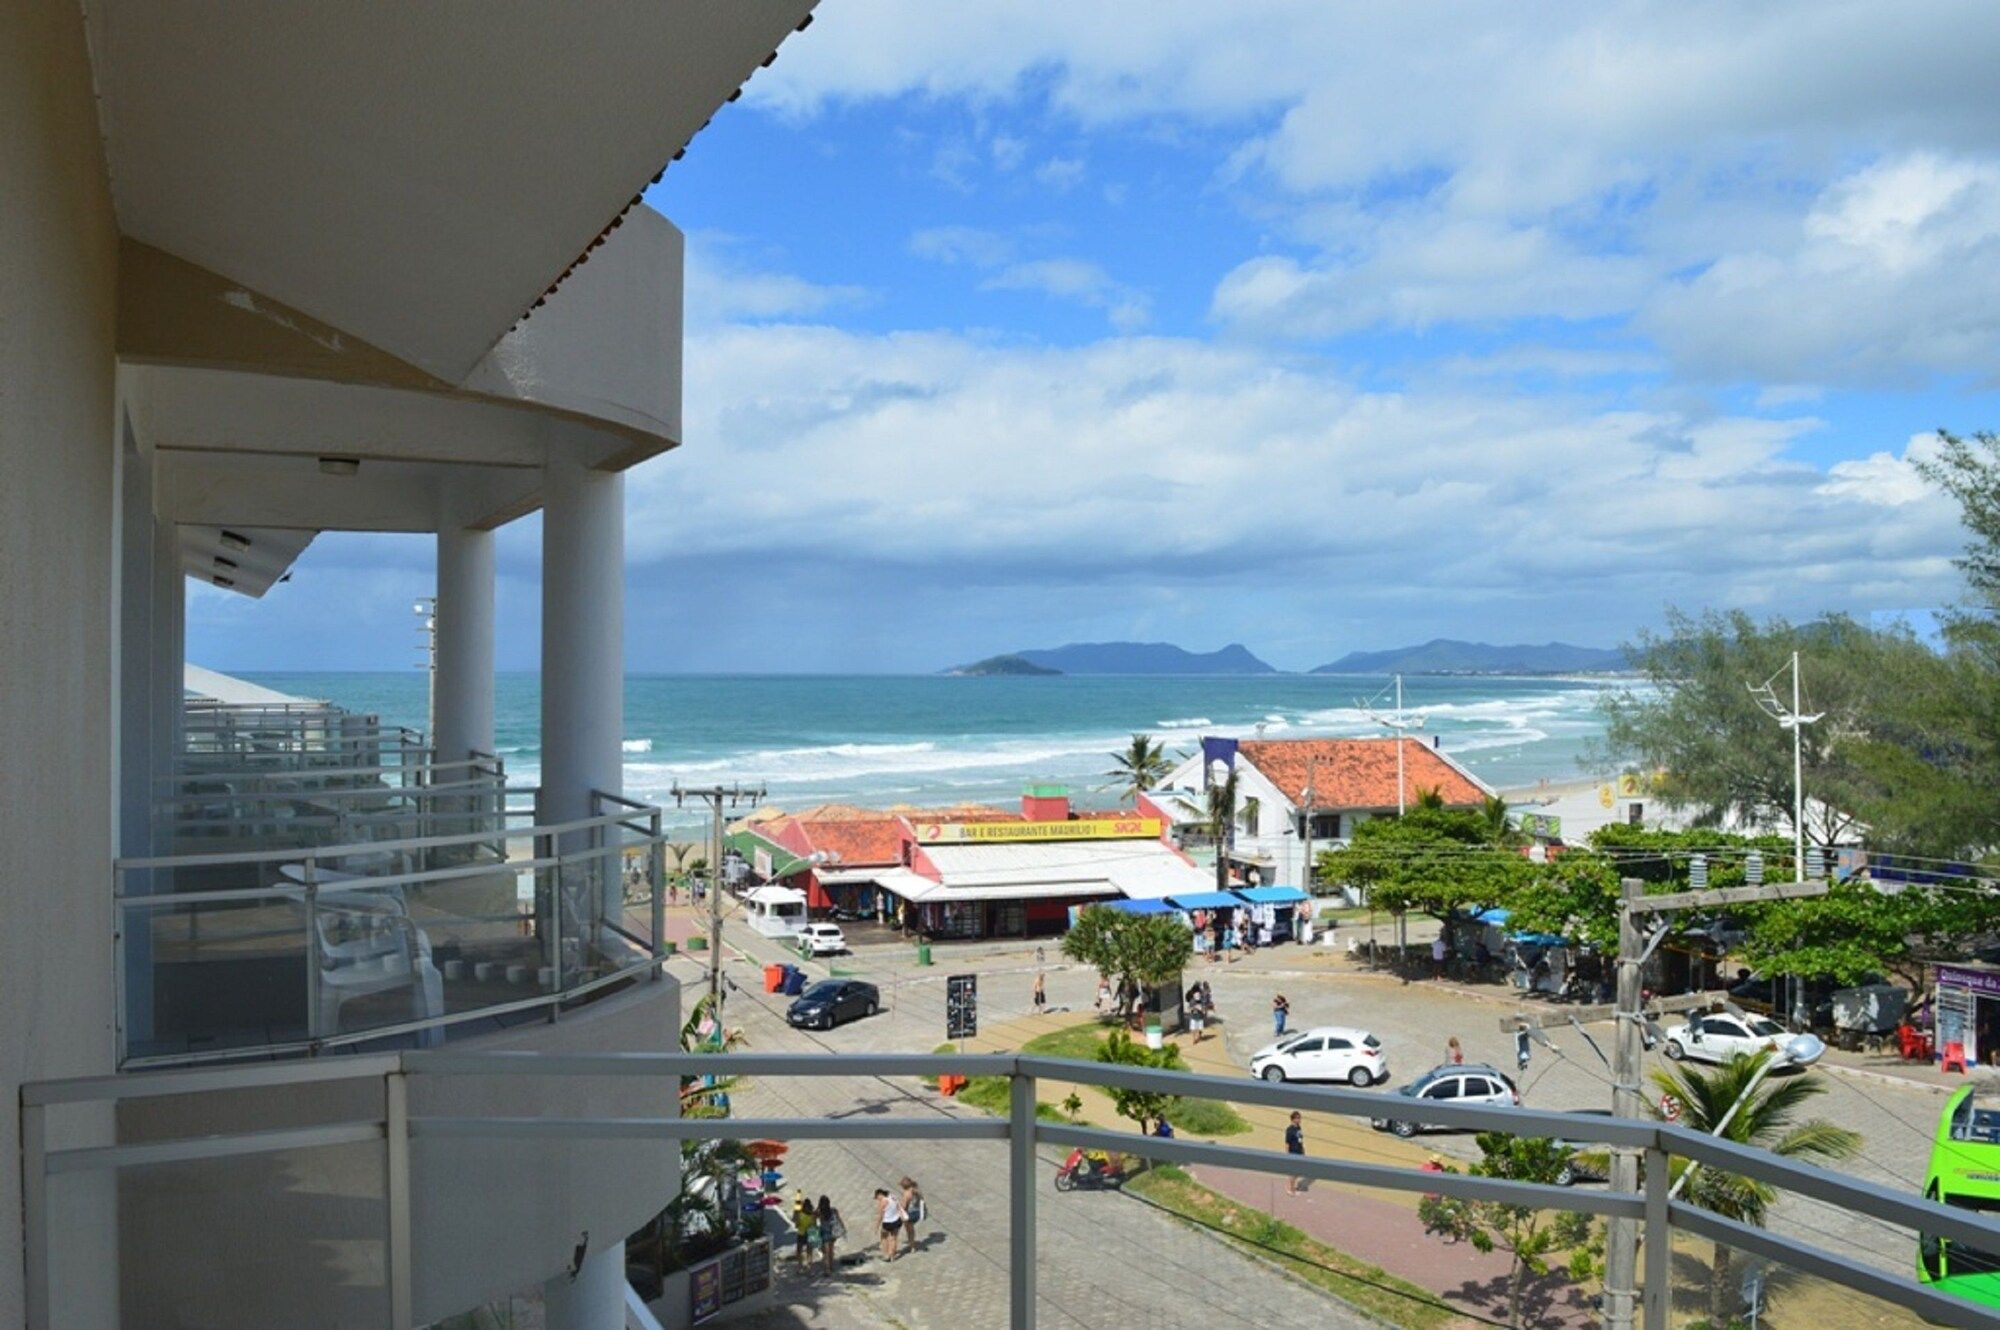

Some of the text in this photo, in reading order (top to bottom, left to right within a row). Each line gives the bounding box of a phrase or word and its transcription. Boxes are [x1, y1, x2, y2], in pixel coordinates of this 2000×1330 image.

[959, 827, 977, 838] BAR
[980, 827, 985, 837] E
[987, 825, 1047, 838] RESTAURANTE
